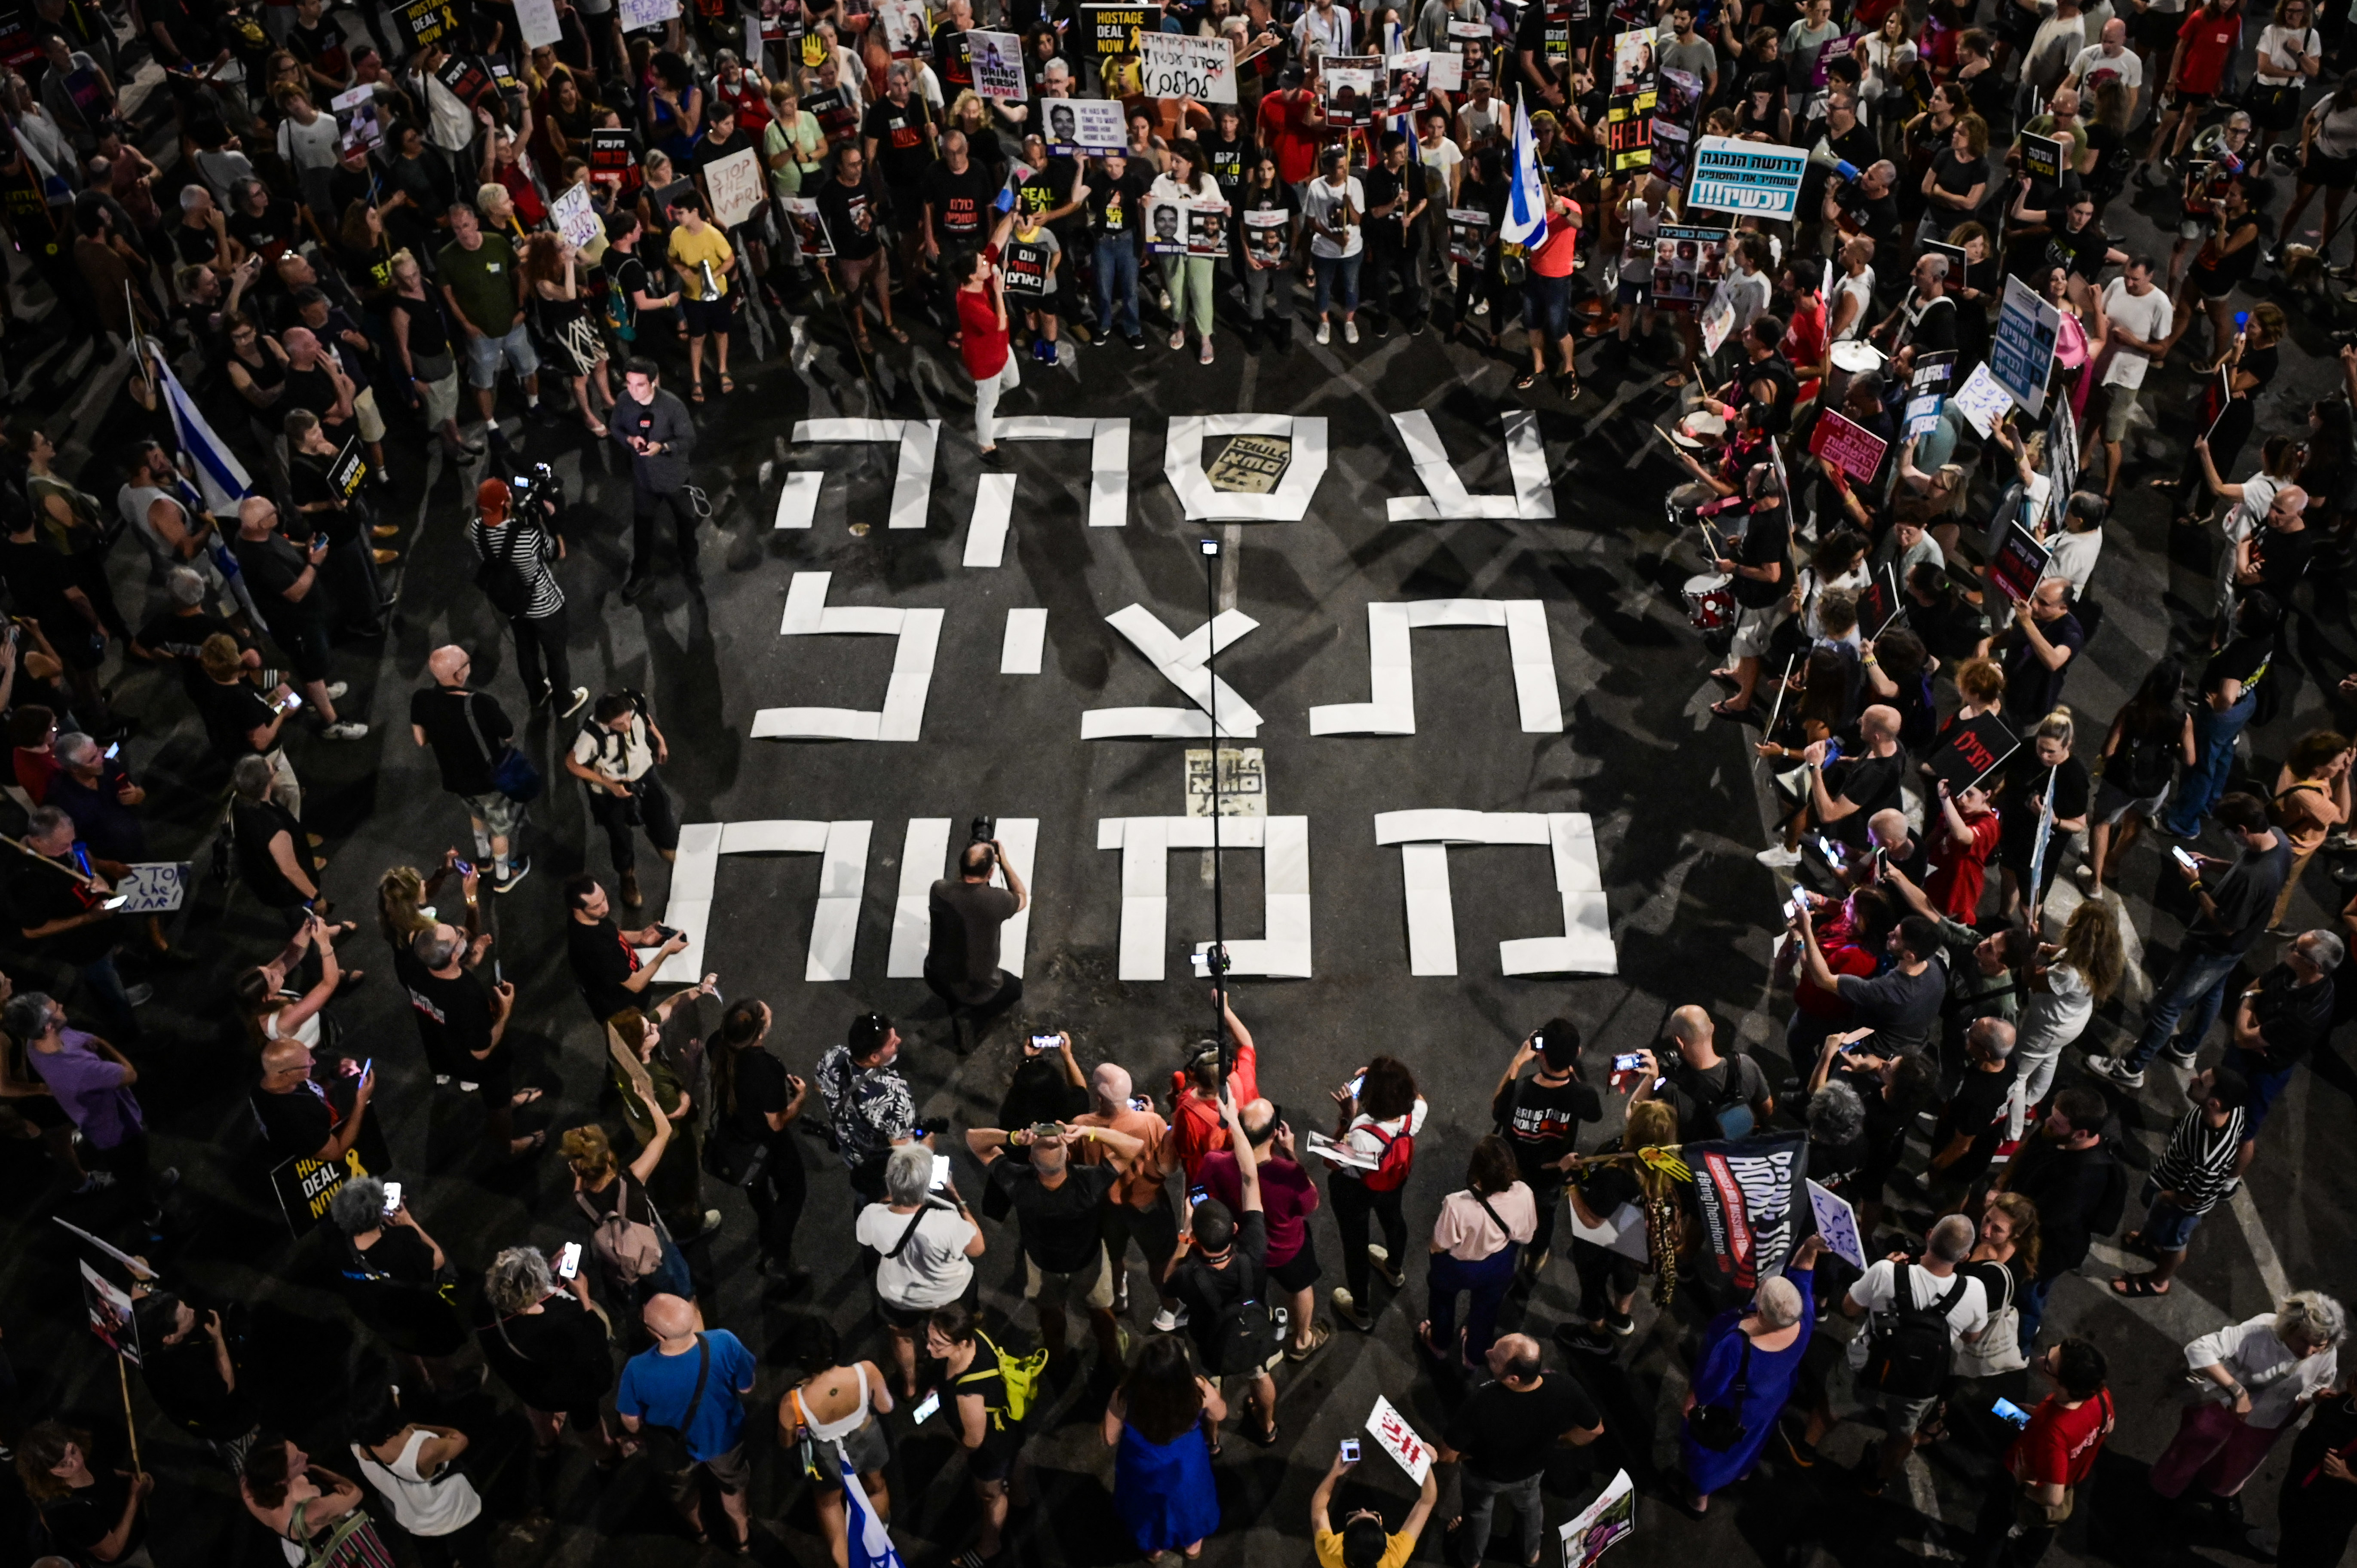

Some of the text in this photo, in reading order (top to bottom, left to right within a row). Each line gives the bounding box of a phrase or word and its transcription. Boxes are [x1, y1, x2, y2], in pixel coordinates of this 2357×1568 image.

[411, 12, 438, 33] DEAL
[1097, 11, 1144, 24] HOSTAGE
[417, 23, 443, 46] NOW
[1097, 25, 1125, 38] DEAL
[1097, 40, 1125, 52] NOW
[980, 66, 1018, 80] BRING
[981, 77, 1019, 88] HERSH
[983, 87, 1021, 98] HOME
[1701, 152, 1802, 172] דרושה הנהגה
[712, 159, 750, 188] STOP
[1698, 170, 1740, 181] החטופים
[1742, 174, 1756, 183] את
[714, 174, 748, 197] THE
[1021, 187, 1055, 201] SEAL
[557, 184, 585, 218] STOP
[718, 180, 761, 214] WAR!
[1698, 184, 1788, 211] עכשיו!!!
[1018, 249, 1036, 262] עם
[1012, 260, 1042, 276] חטוף
[1006, 272, 1042, 288] בארצו
[2001, 321, 2048, 366] אין סופית
[2035, 321, 2056, 348] לא
[2030, 364, 2042, 386] כן
[1958, 368, 1989, 411] STOP
[1972, 389, 1997, 411] the
[1825, 412, 1846, 429] את
[775, 410, 1556, 568] עסקה
[750, 571, 1563, 741] תציל
[1953, 730, 1995, 773] הצילו
[139, 882, 170, 897] the
[1515, 1106, 1544, 1121] BRING
[301, 1162, 340, 1199] DEAL
[1726, 1190, 1739, 1204] AND
[1729, 1204, 1746, 1240] MISSING
